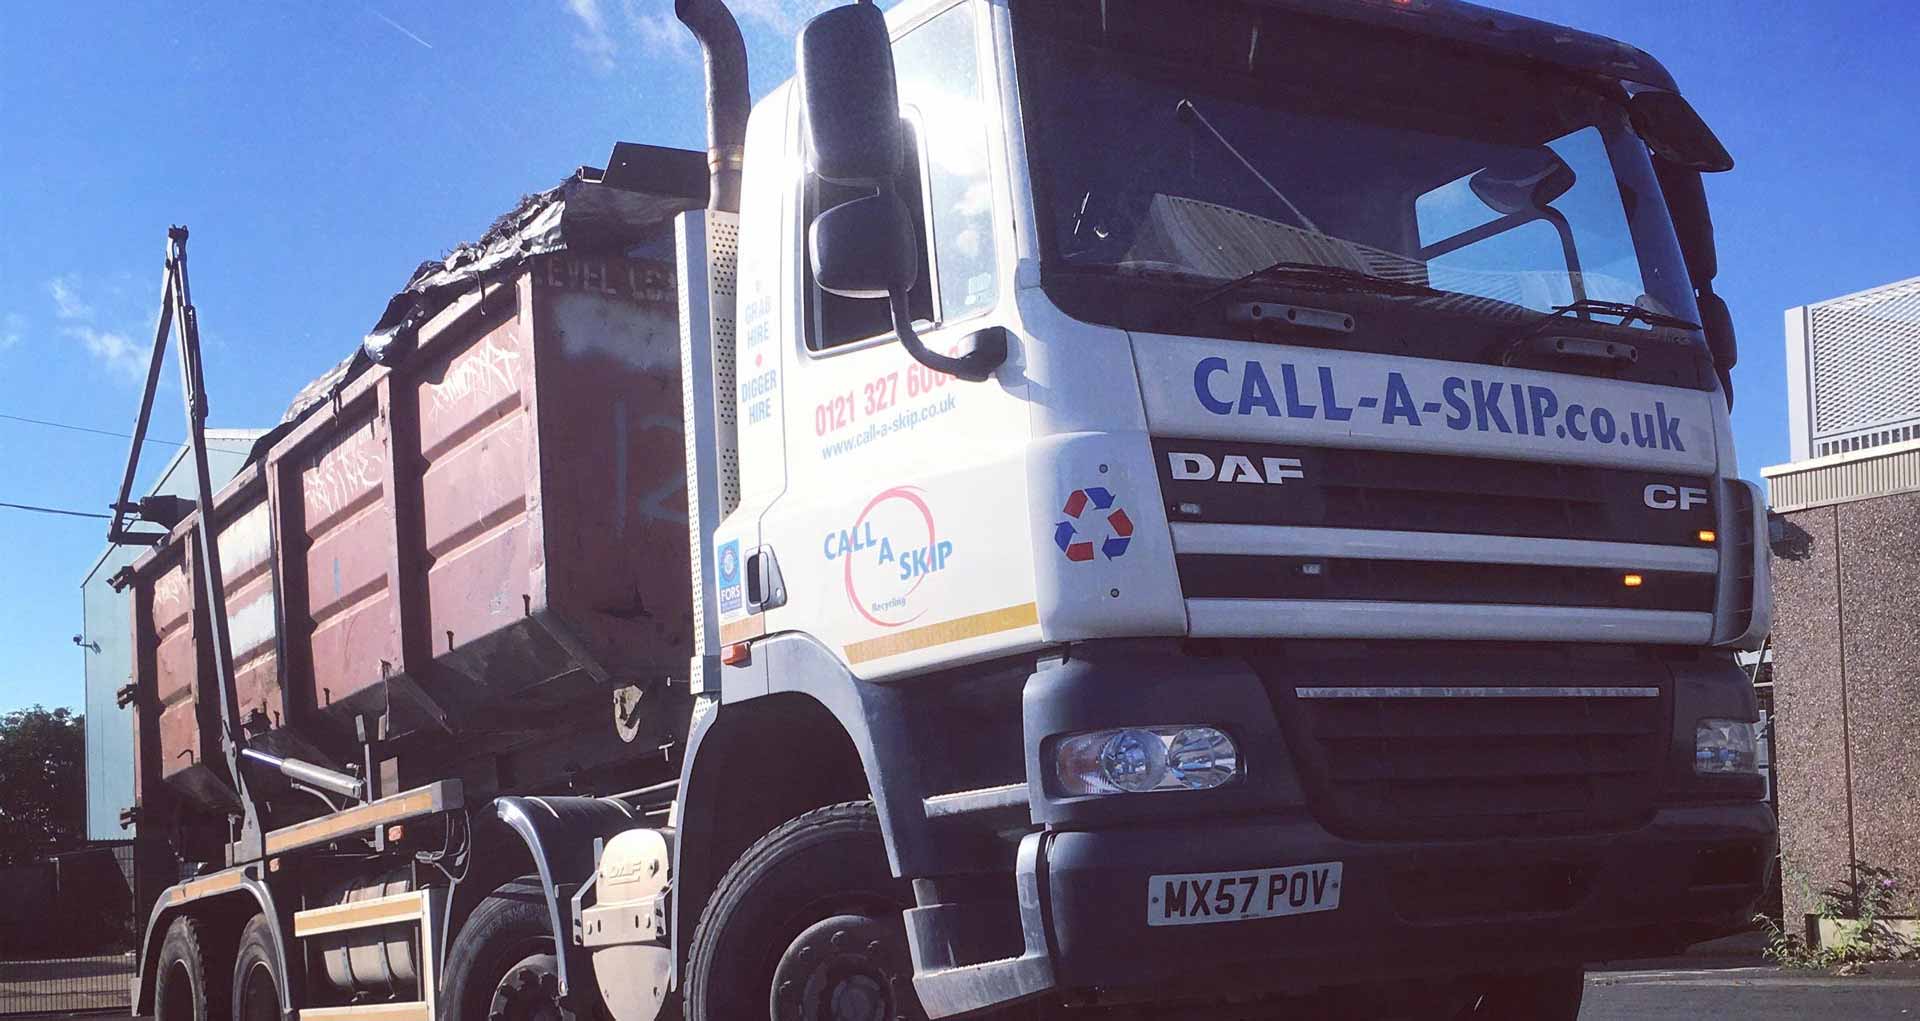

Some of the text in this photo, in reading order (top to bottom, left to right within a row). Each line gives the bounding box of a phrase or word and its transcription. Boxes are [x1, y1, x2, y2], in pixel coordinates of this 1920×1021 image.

[744, 296, 772, 325] GRAB
[747, 322, 770, 349] HIRE
[741, 369, 777, 403] DIGGER
[748, 398, 772, 425] HIRE
[815, 390, 855, 437] 0121
[864, 371, 899, 416] 327
[1193, 356, 1687, 452] CALL-A-SKIP.co.uk
[822, 393, 957, 460] www.call-a-skip.co.uk
[1167, 451, 1304, 485] DAF
[1643, 483, 1708, 511] CF
[823, 521, 954, 581] CALL A SKIP
[720, 585, 741, 602] FORS
[871, 596, 907, 613] Recycling
[1164, 868, 1330, 919] MX57 POV
